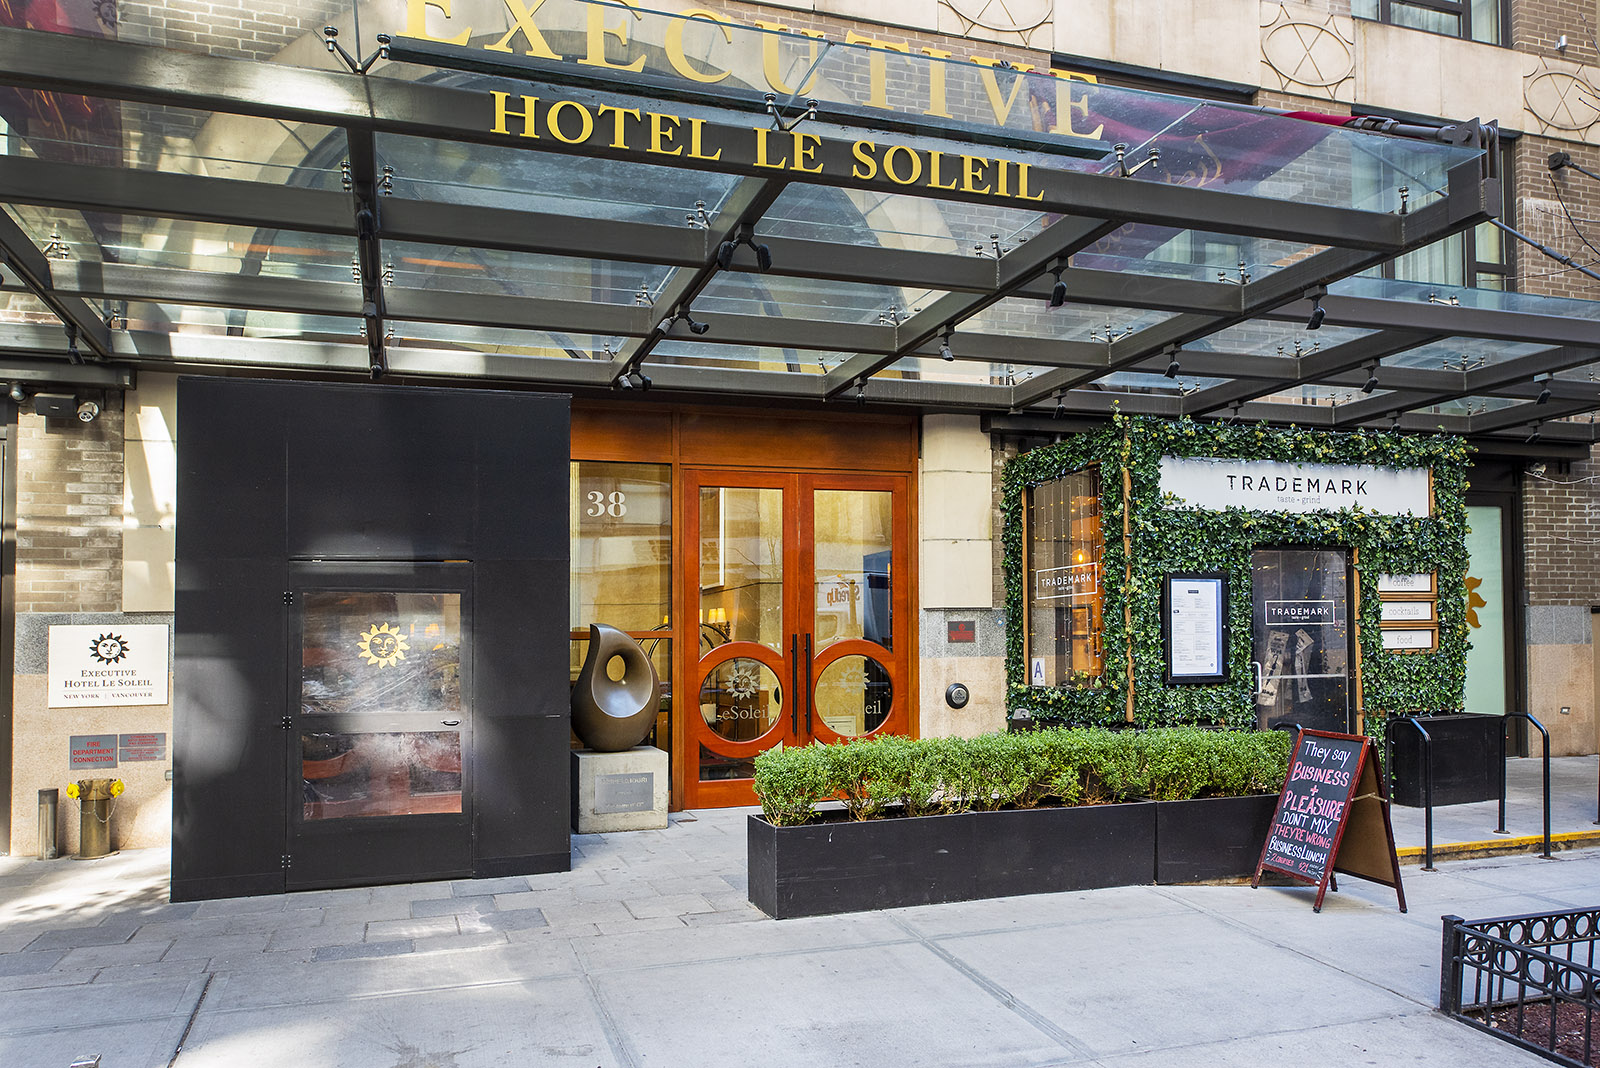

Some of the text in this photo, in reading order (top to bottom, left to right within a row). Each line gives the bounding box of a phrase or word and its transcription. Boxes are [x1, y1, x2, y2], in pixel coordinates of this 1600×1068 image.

[396, 0, 1104, 140] EXECUTIVE
[490, 90, 722, 161] HOTEL
[753, 127, 823, 173] LE
[852, 140, 1045, 201] SOLEIL
[1226, 475, 1369, 495] TRADEMARK
[586, 490, 628, 518] 38
[1277, 495, 1321, 506] taste grind
[1041, 573, 1092, 587] TRADEMARK
[1392, 577, 1415, 587] coffee
[1271, 607, 1330, 616] TRADEMARK
[1388, 606, 1420, 616] cocktails
[1396, 634, 1413, 645] food
[81, 669, 137, 678] EXECUTIVE
[1034, 661, 1043, 678] A
[64, 678, 153, 688] HOTEL LE SOLEIL
[72, 748, 114, 756] DEPARTMENT
[1304, 740, 1351, 769] They say
[73, 756, 114, 764] CONNECTION
[1291, 761, 1351, 787] BUSINESS
[1282, 790, 1345, 822] PLEASURE
[1310, 819, 1333, 835] MIX
[1305, 830, 1332, 849] WRONG
